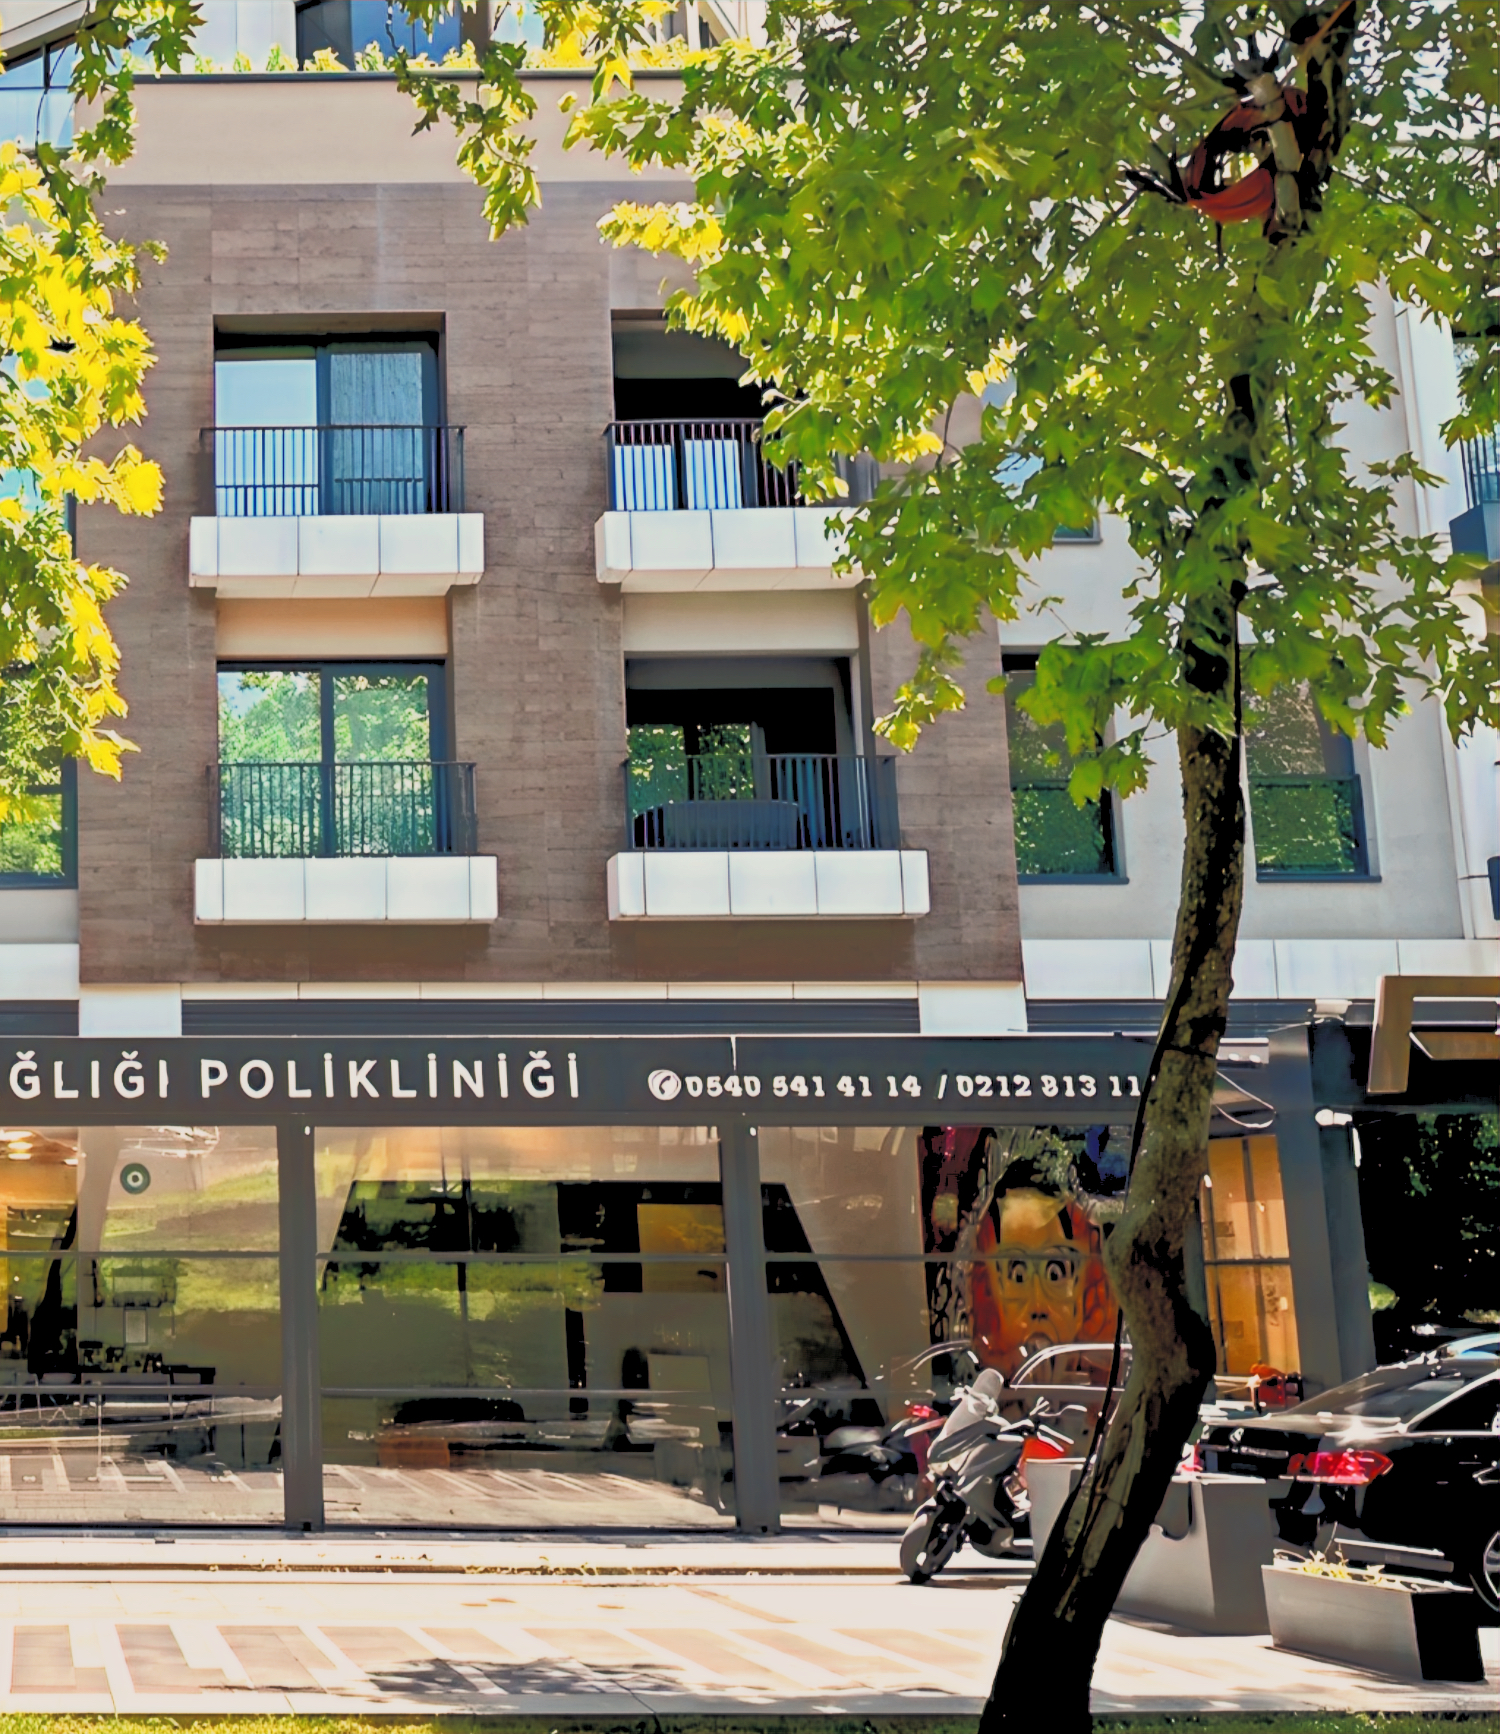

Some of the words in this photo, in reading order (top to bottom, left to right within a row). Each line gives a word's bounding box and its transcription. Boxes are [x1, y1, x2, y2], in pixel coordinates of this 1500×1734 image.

[200, 1050, 579, 1099] POLİKLİNİĞİ
[685, 1075, 761, 1097] 0540
[773, 1075, 825, 1097] 541
[836, 1075, 873, 1097] 41
[886, 1075, 922, 1097] 14
[1040, 1074, 1097, 1098] 813
